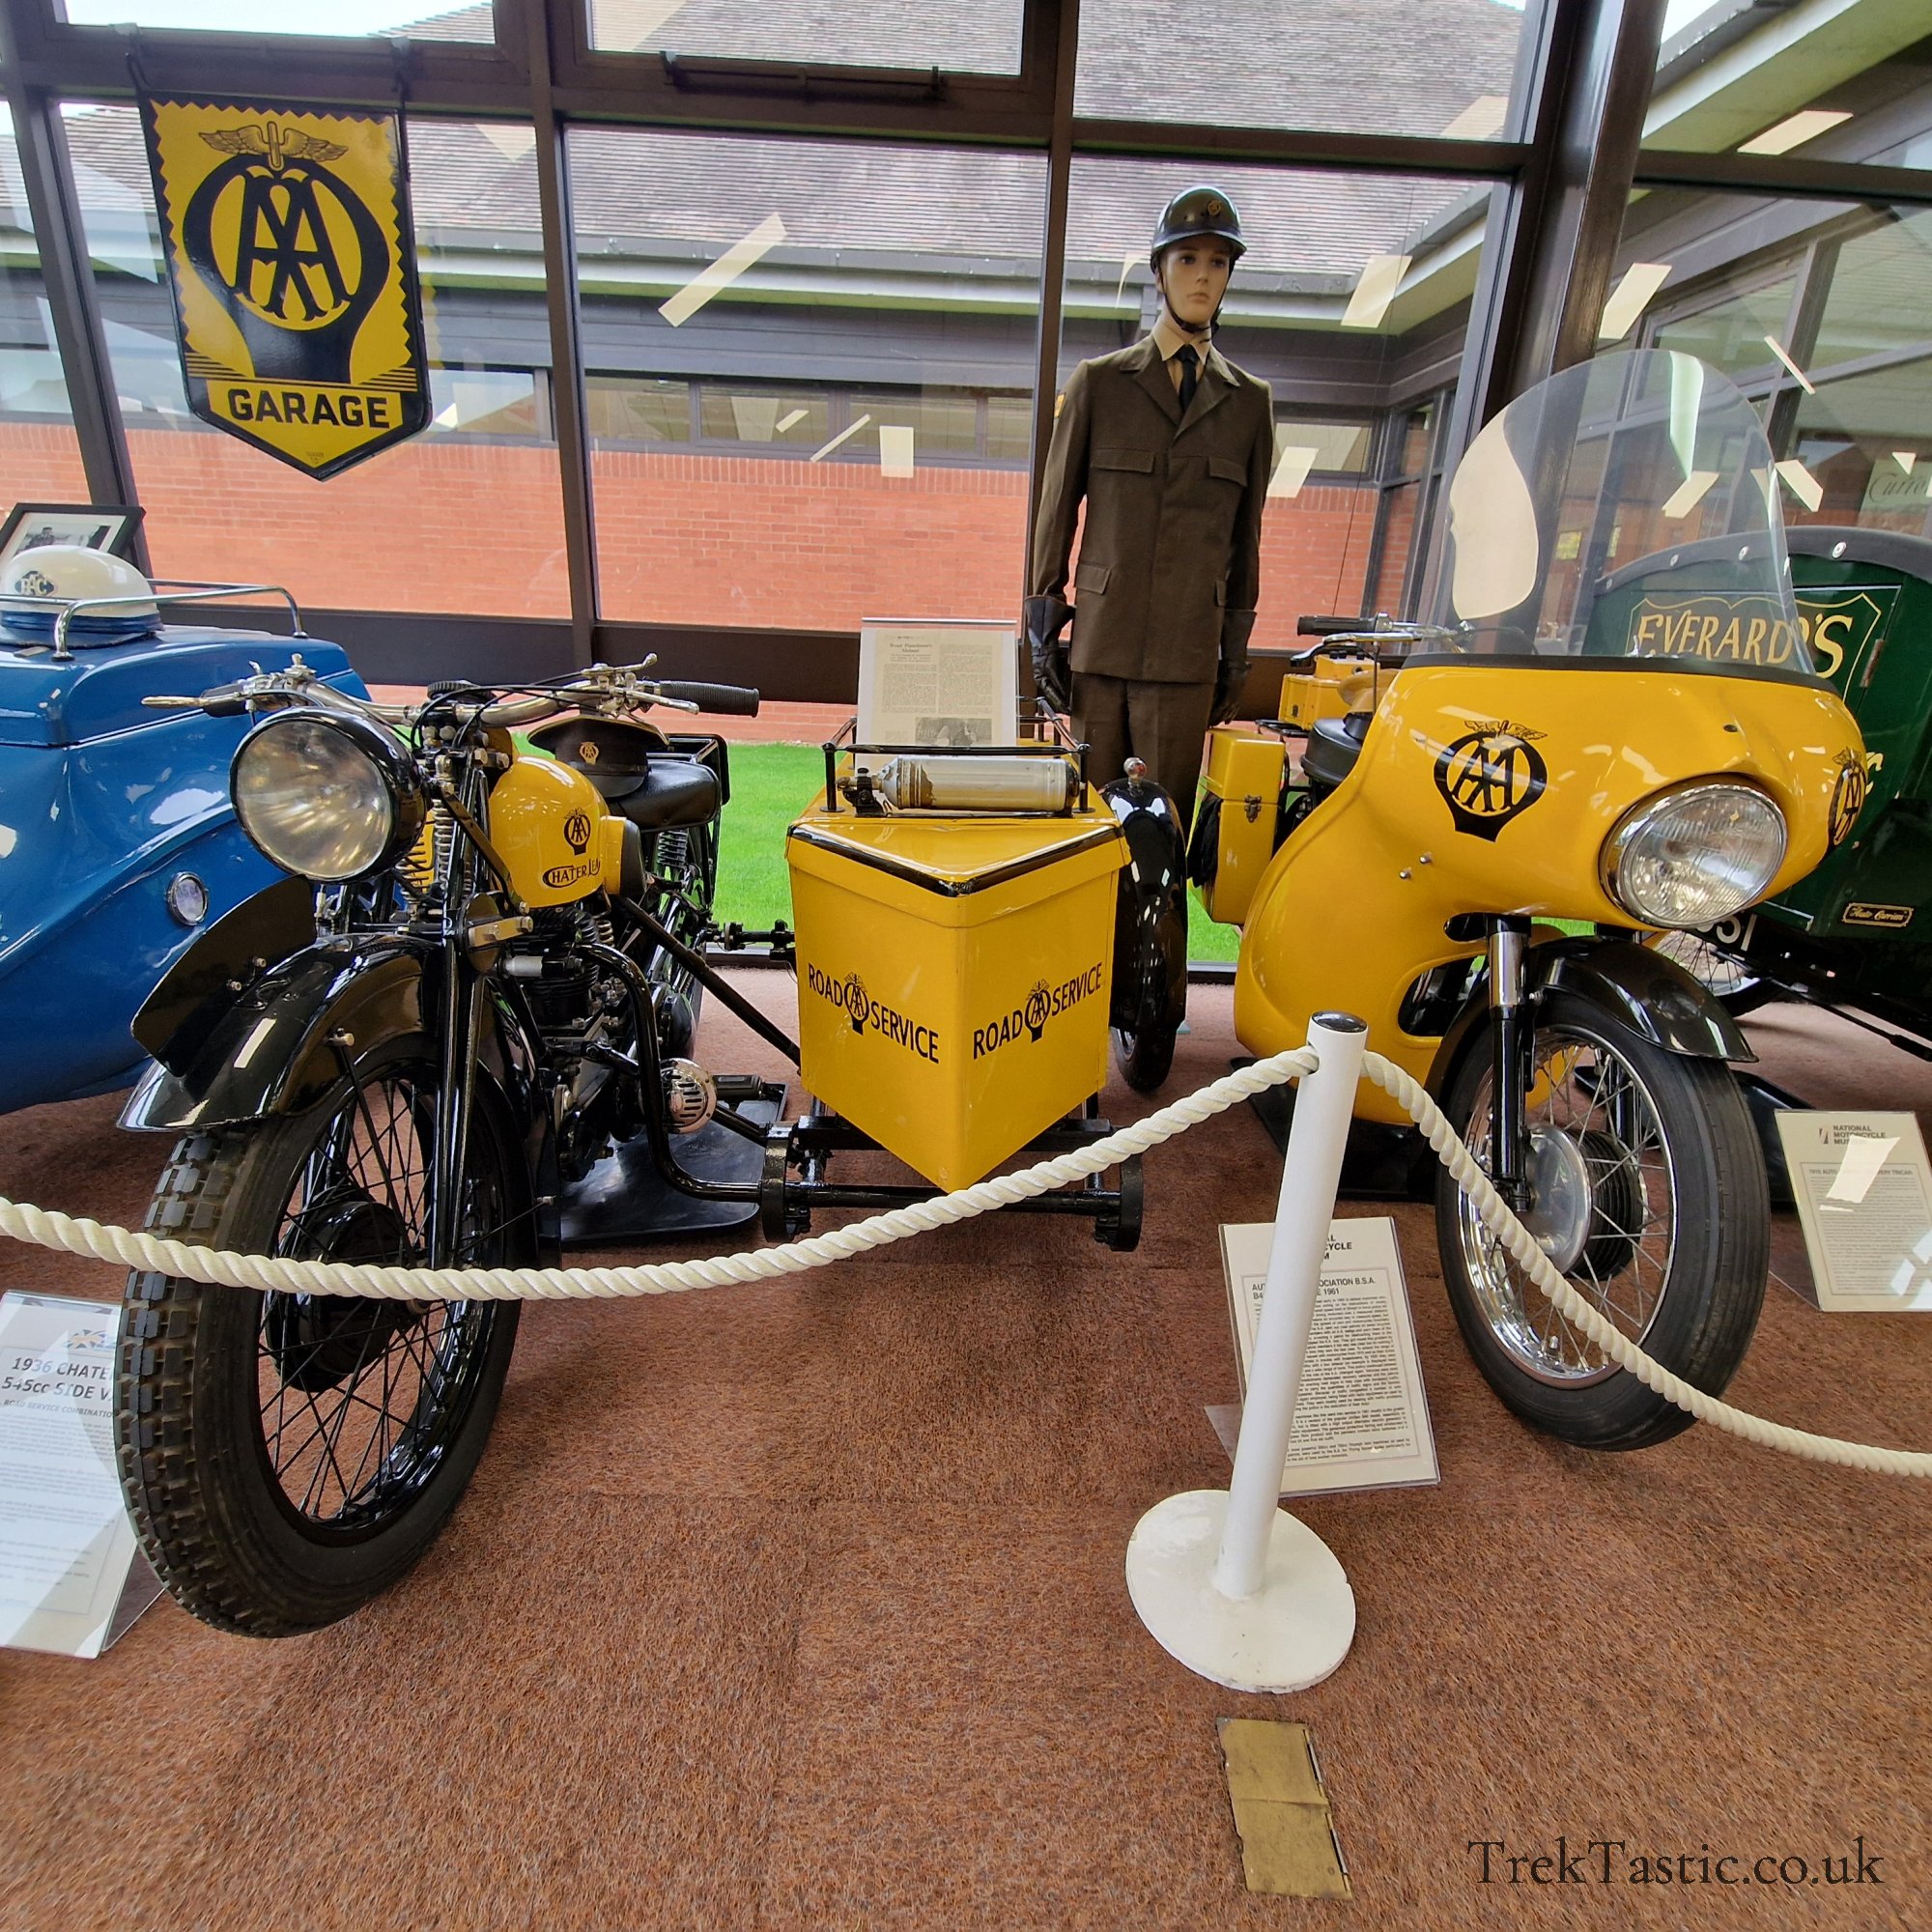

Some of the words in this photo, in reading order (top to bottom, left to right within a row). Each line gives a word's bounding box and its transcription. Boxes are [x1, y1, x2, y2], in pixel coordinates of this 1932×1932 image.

[226, 387, 391, 430] GARAGE
[1696, 913, 1758, 952] 51
[808, 962, 843, 1008] ROAD
[870, 1000, 940, 1065] SERVICE
[973, 1009, 1022, 1061] ROAD
[1051, 962, 1103, 1016] SERVICE
[1319, 1277, 1353, 1288] OCIATION
[12, 1356, 52, 1374] 1936
[56, 1362, 112, 1380] CHATE
[53, 1381, 96, 1399] SIDE
[27, 1401, 60, 1413] SERVICE
[61, 1406, 113, 1419] COMBINATIO
